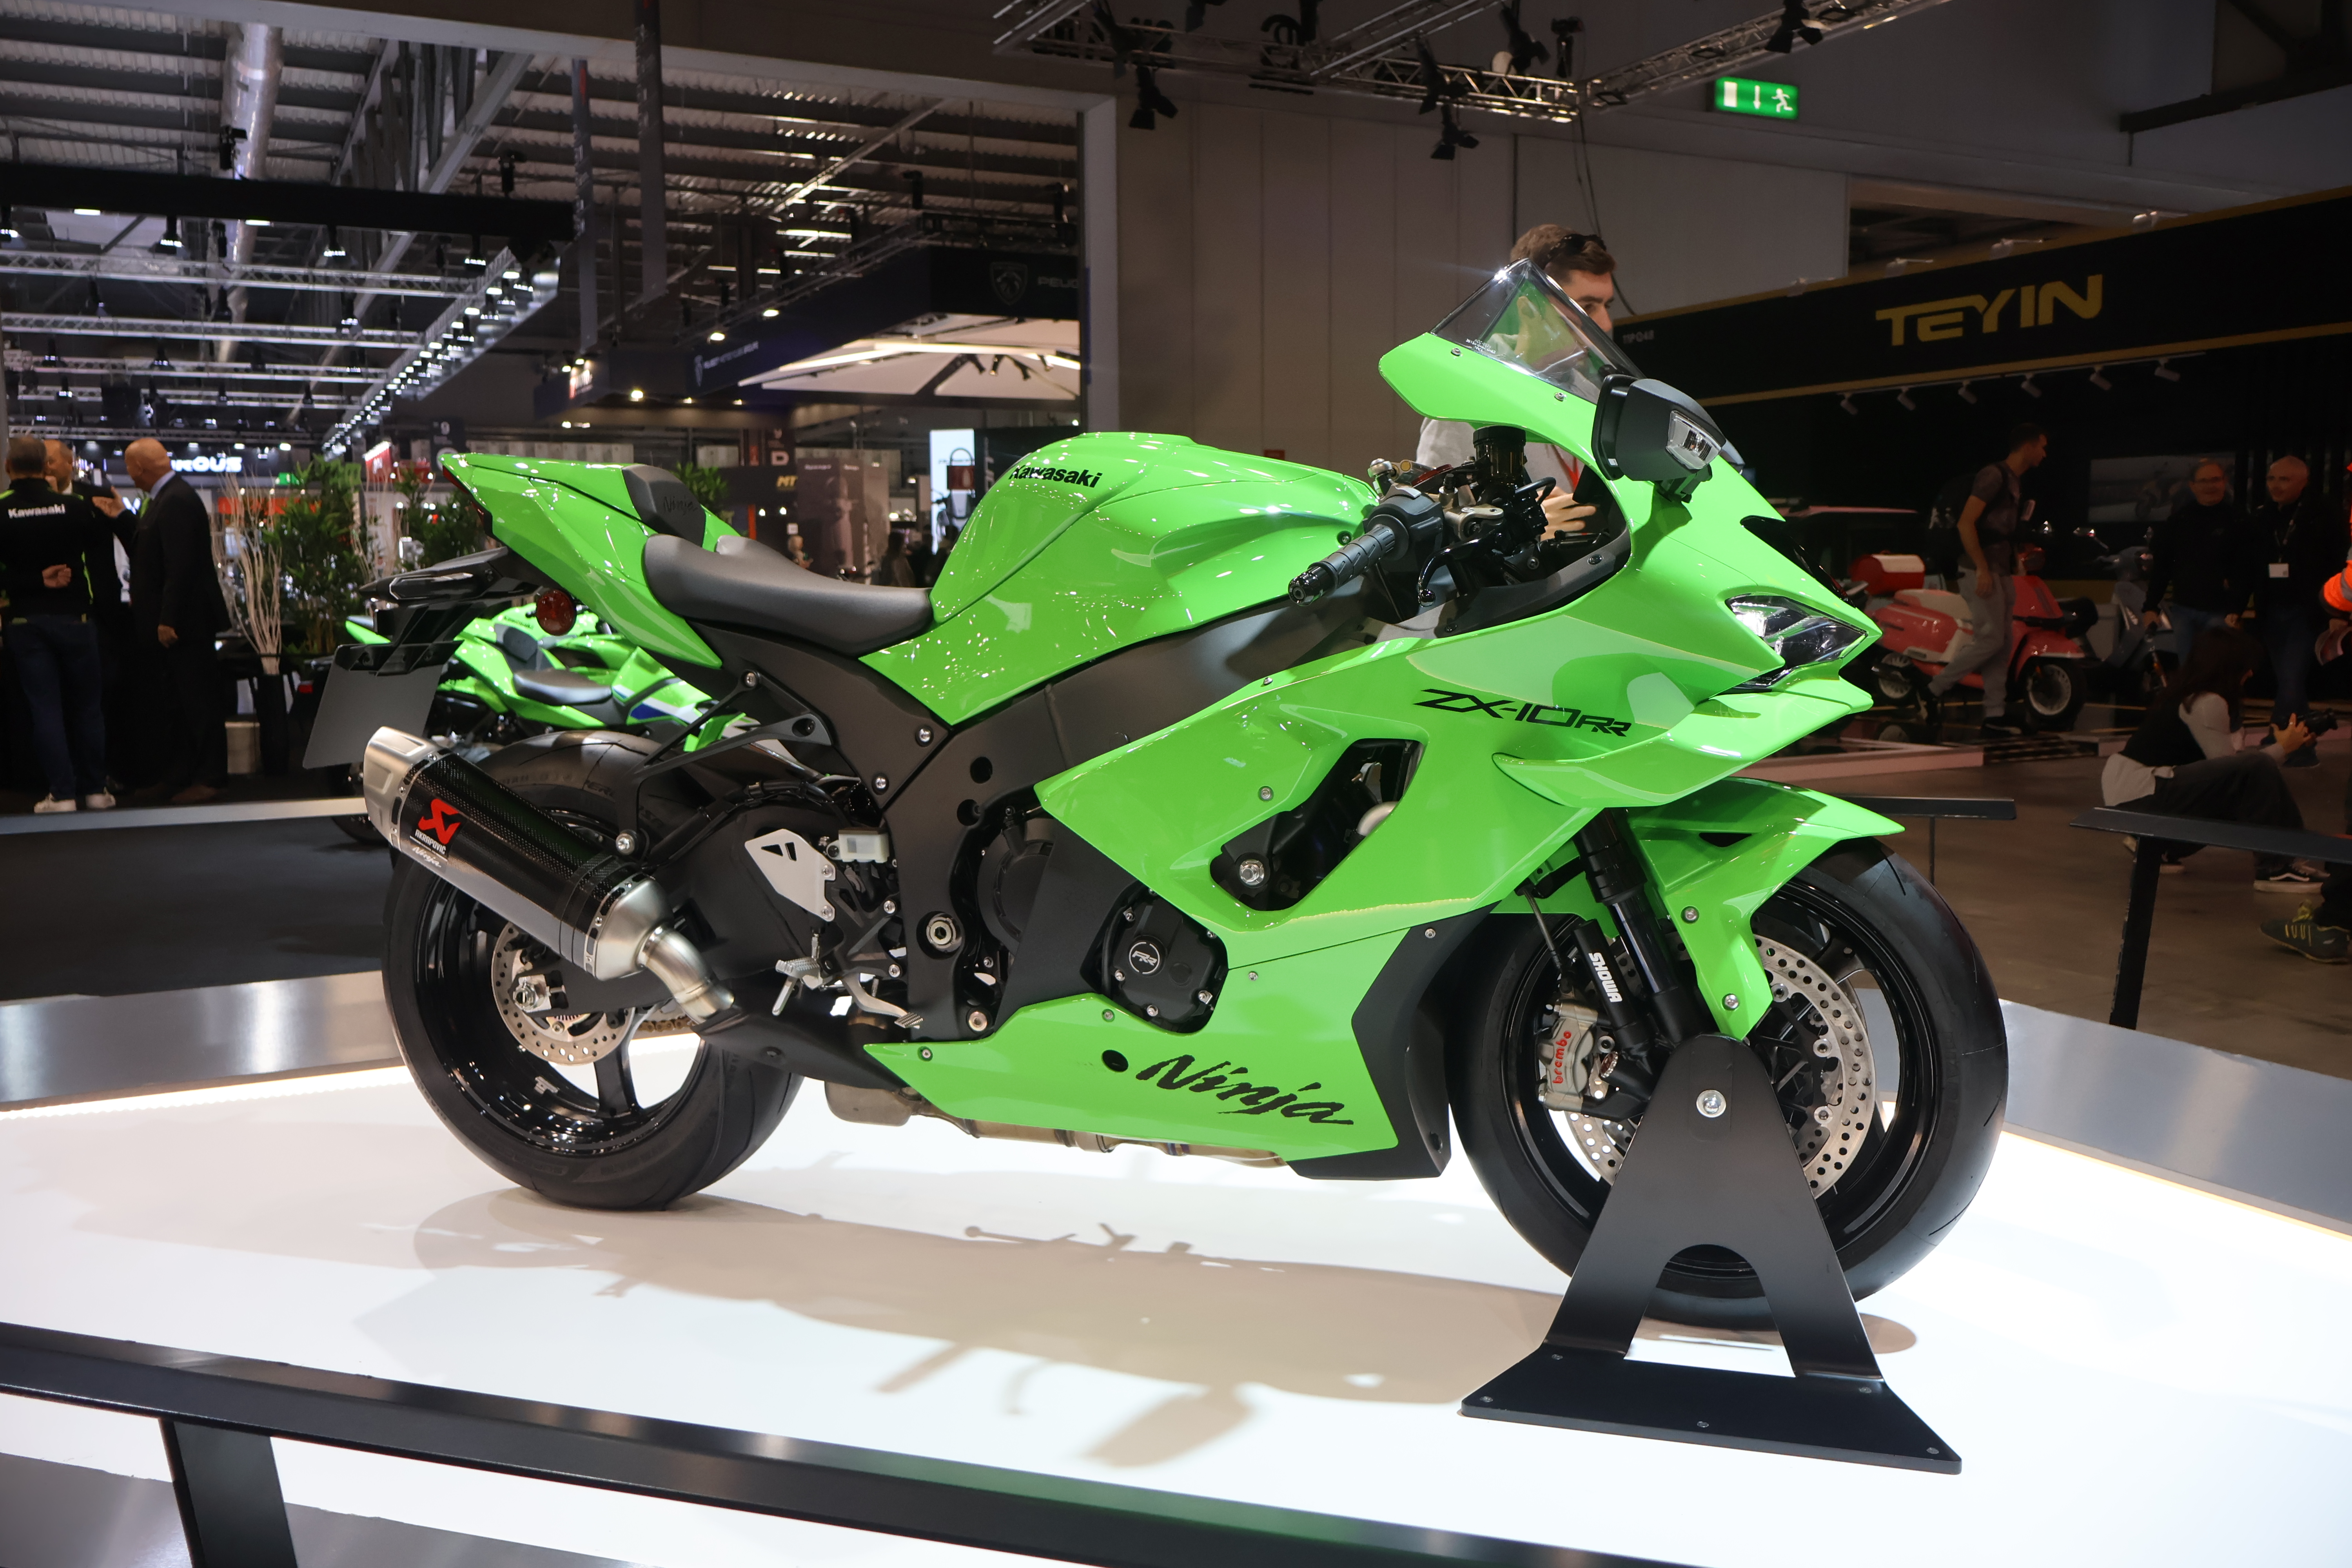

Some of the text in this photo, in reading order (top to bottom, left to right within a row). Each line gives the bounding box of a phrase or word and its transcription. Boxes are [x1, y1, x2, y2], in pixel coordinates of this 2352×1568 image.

[1875, 274, 2103, 347] TEYIN
[1008, 465, 1103, 488] Kawasaki
[8, 503, 66, 519] Kawasaki
[412, 846, 442, 867] Ninja
[1588, 952, 1623, 1003] SHOWA
[1552, 1030, 1572, 1084] brembo
[1135, 1054, 1354, 1125] Ninja
